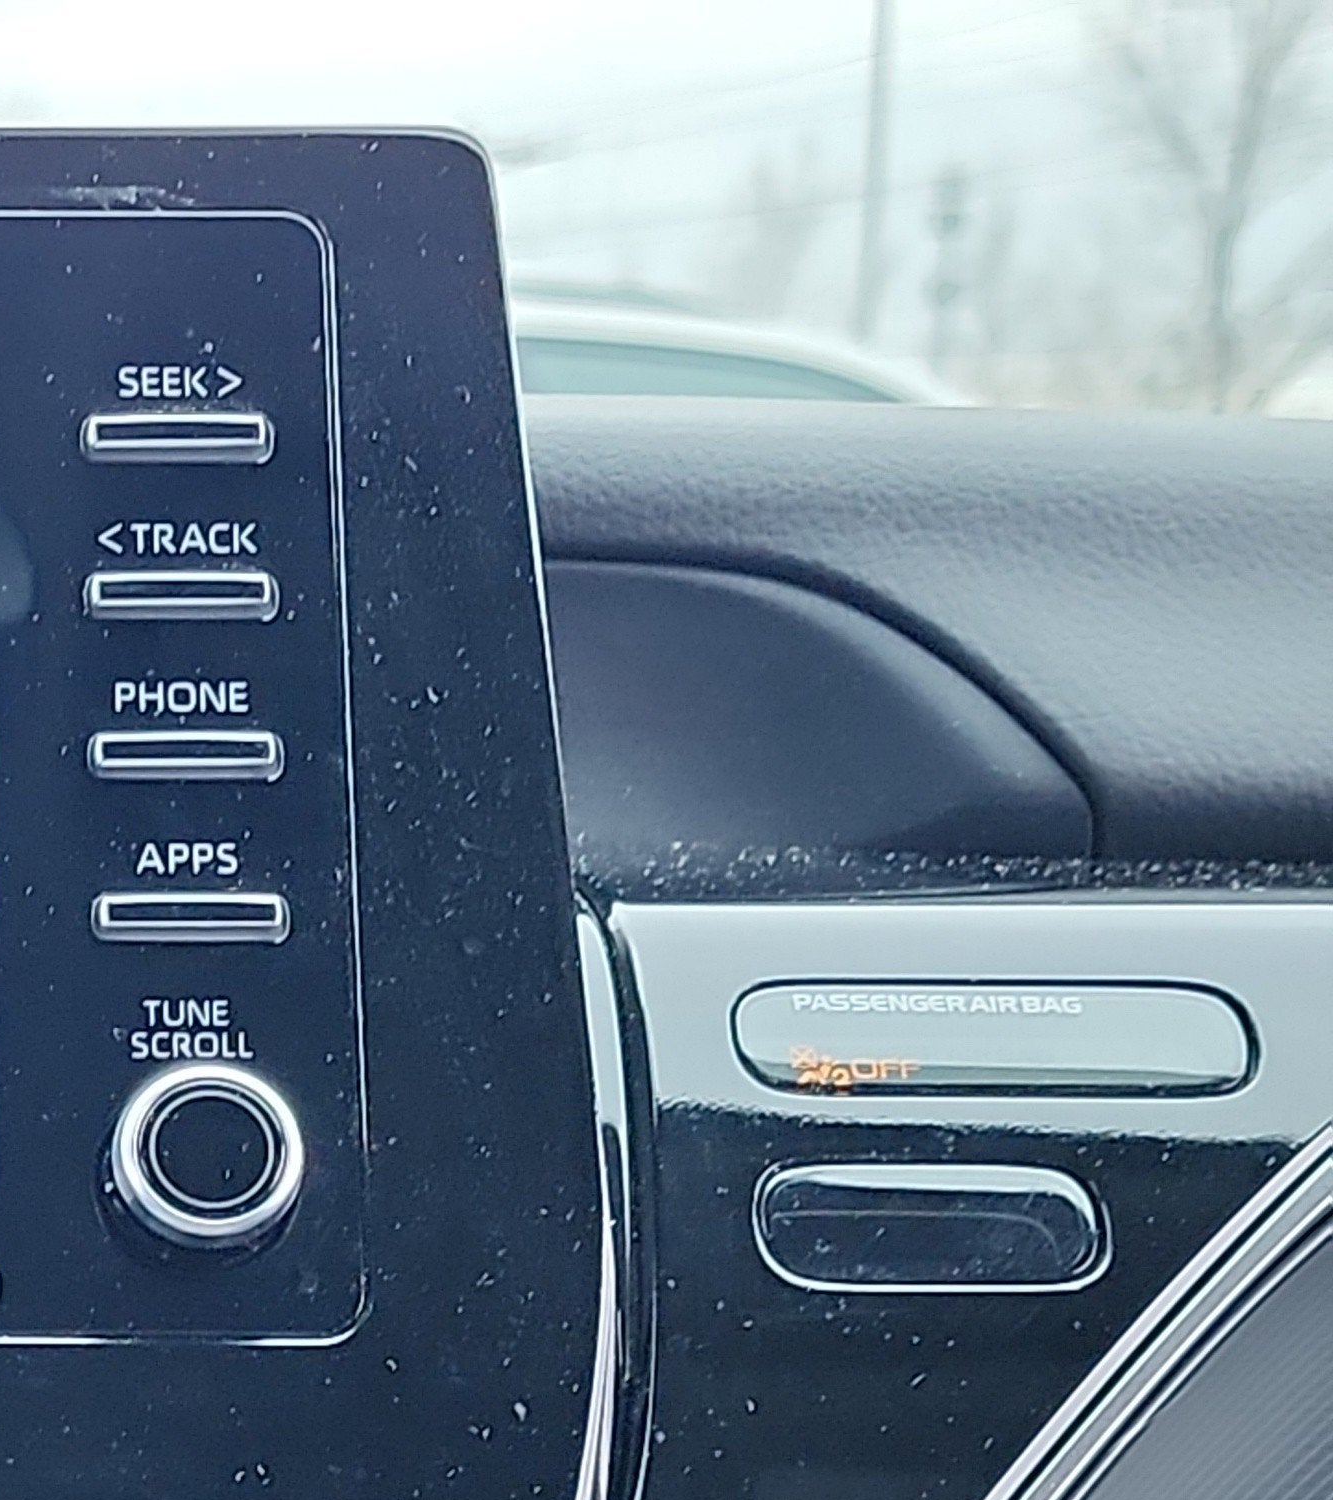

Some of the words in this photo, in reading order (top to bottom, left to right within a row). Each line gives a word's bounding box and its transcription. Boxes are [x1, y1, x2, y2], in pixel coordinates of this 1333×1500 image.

[114, 681, 249, 713] PHONE
[136, 843, 238, 875] APPS
[143, 999, 230, 1028] TUNE
[791, 993, 967, 1013] PASSENGER
[970, 995, 1018, 1014] AIR
[1020, 996, 1083, 1014] BAG
[130, 1031, 253, 1060] SCROLL
[852, 1059, 921, 1080] OFF
